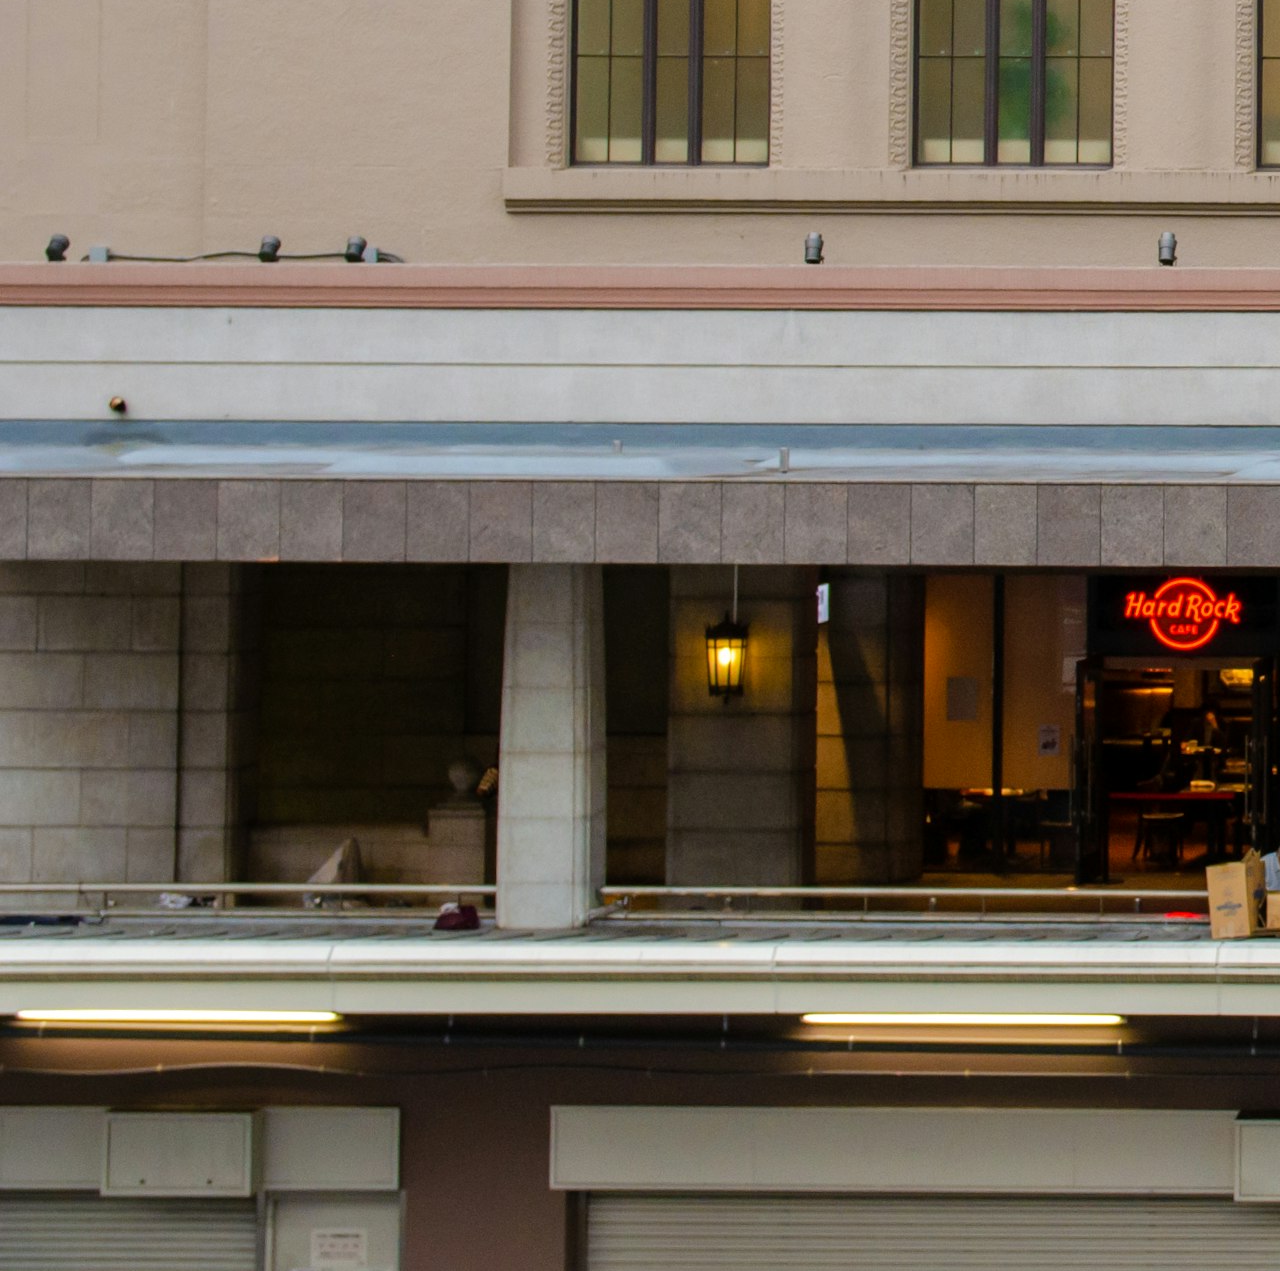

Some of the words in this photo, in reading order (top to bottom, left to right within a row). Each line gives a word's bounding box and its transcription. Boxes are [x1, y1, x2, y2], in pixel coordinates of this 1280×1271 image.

[1124, 591, 1184, 618] Hard
[1185, 592, 1242, 623] Rock
[1169, 624, 1199, 635] CAFE
